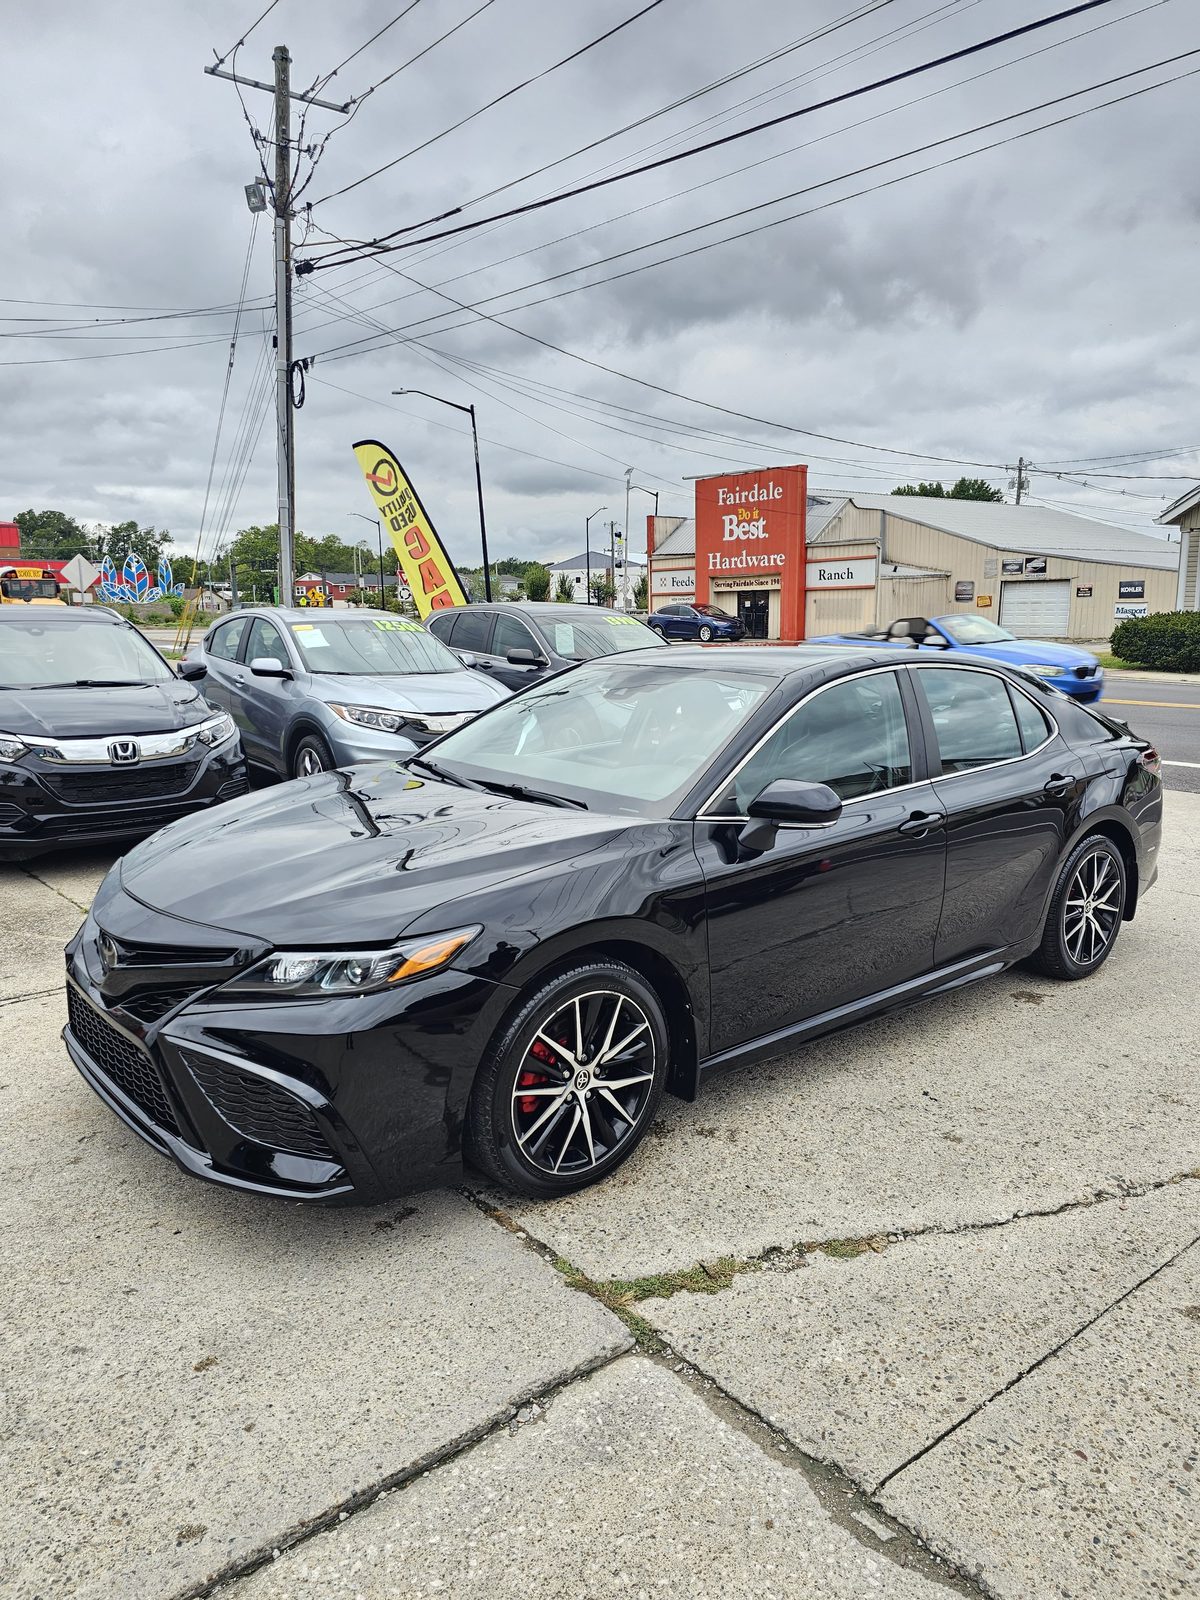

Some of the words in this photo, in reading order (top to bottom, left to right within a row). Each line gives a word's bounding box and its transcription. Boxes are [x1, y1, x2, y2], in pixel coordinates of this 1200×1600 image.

[717, 481, 783, 505] Fairdale
[738, 508, 751, 520] Do
[753, 507, 760, 520] it
[707, 550, 786, 570] Hardware
[818, 567, 854, 581] Ranch
[671, 576, 695, 587] Feeds
[714, 581, 733, 589] Serving
[1115, 607, 1147, 615] Masport
